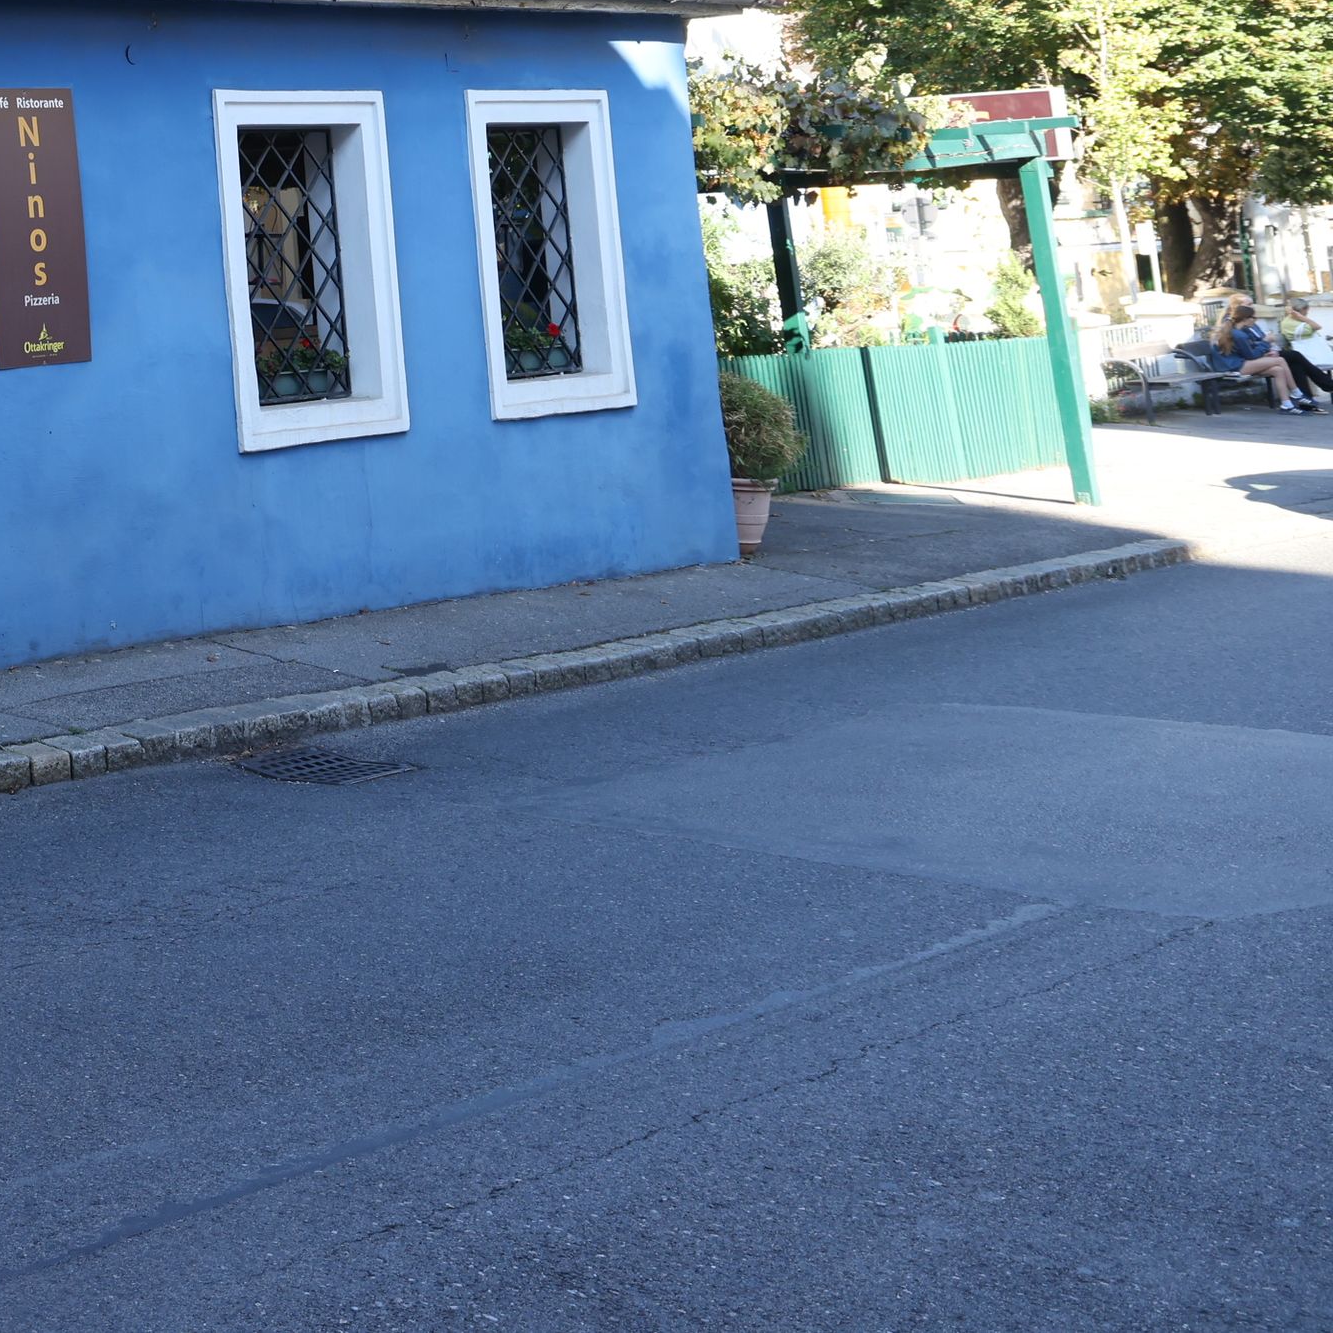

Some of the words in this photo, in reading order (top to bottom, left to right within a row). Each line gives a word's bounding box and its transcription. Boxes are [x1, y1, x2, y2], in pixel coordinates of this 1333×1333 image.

[16, 96, 64, 109] Ristorante
[17, 116, 48, 286] Ninos
[24, 294, 60, 306] Pizzeria
[24, 340, 65, 354] Ottakringer
